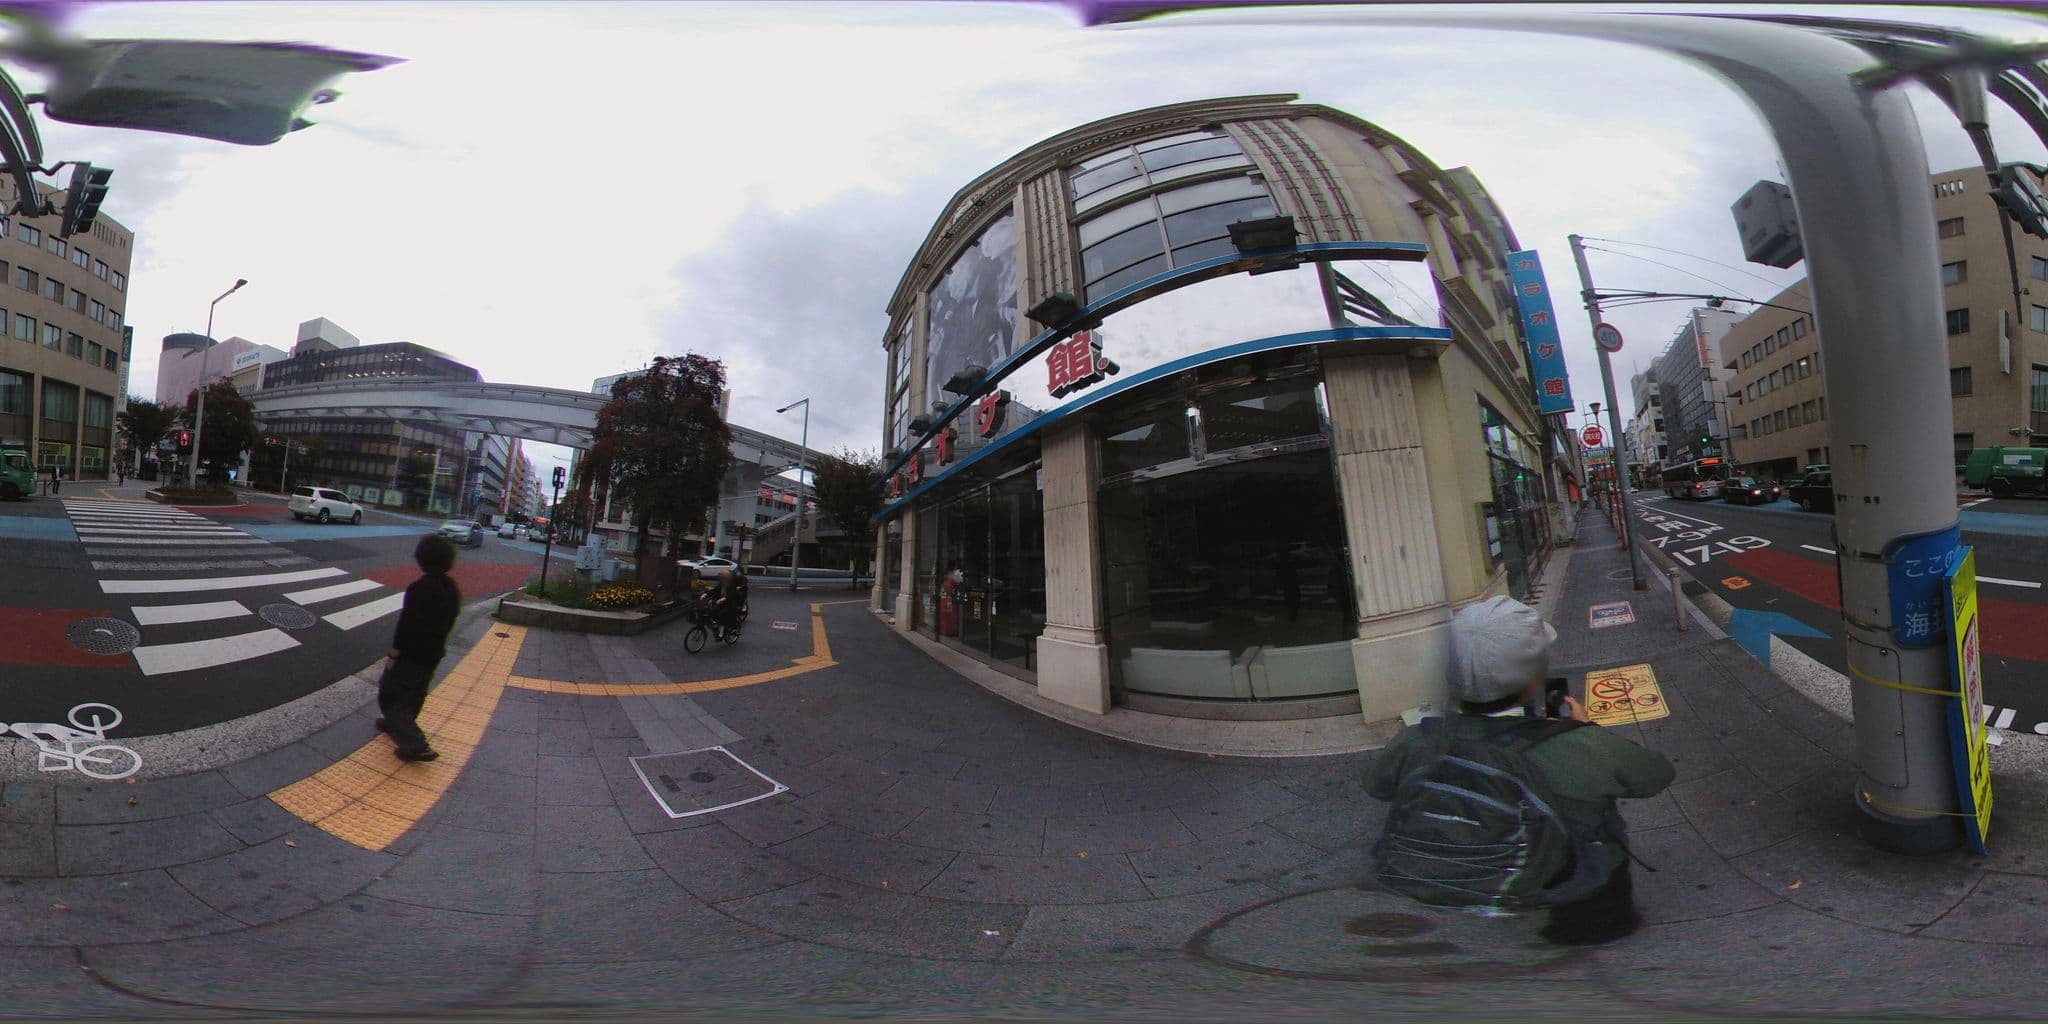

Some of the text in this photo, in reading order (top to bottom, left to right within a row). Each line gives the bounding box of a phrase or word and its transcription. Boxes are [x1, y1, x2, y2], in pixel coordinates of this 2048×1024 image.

[1517, 259, 1565, 397] カラオケ館
[1672, 535, 1772, 567] 17-19
